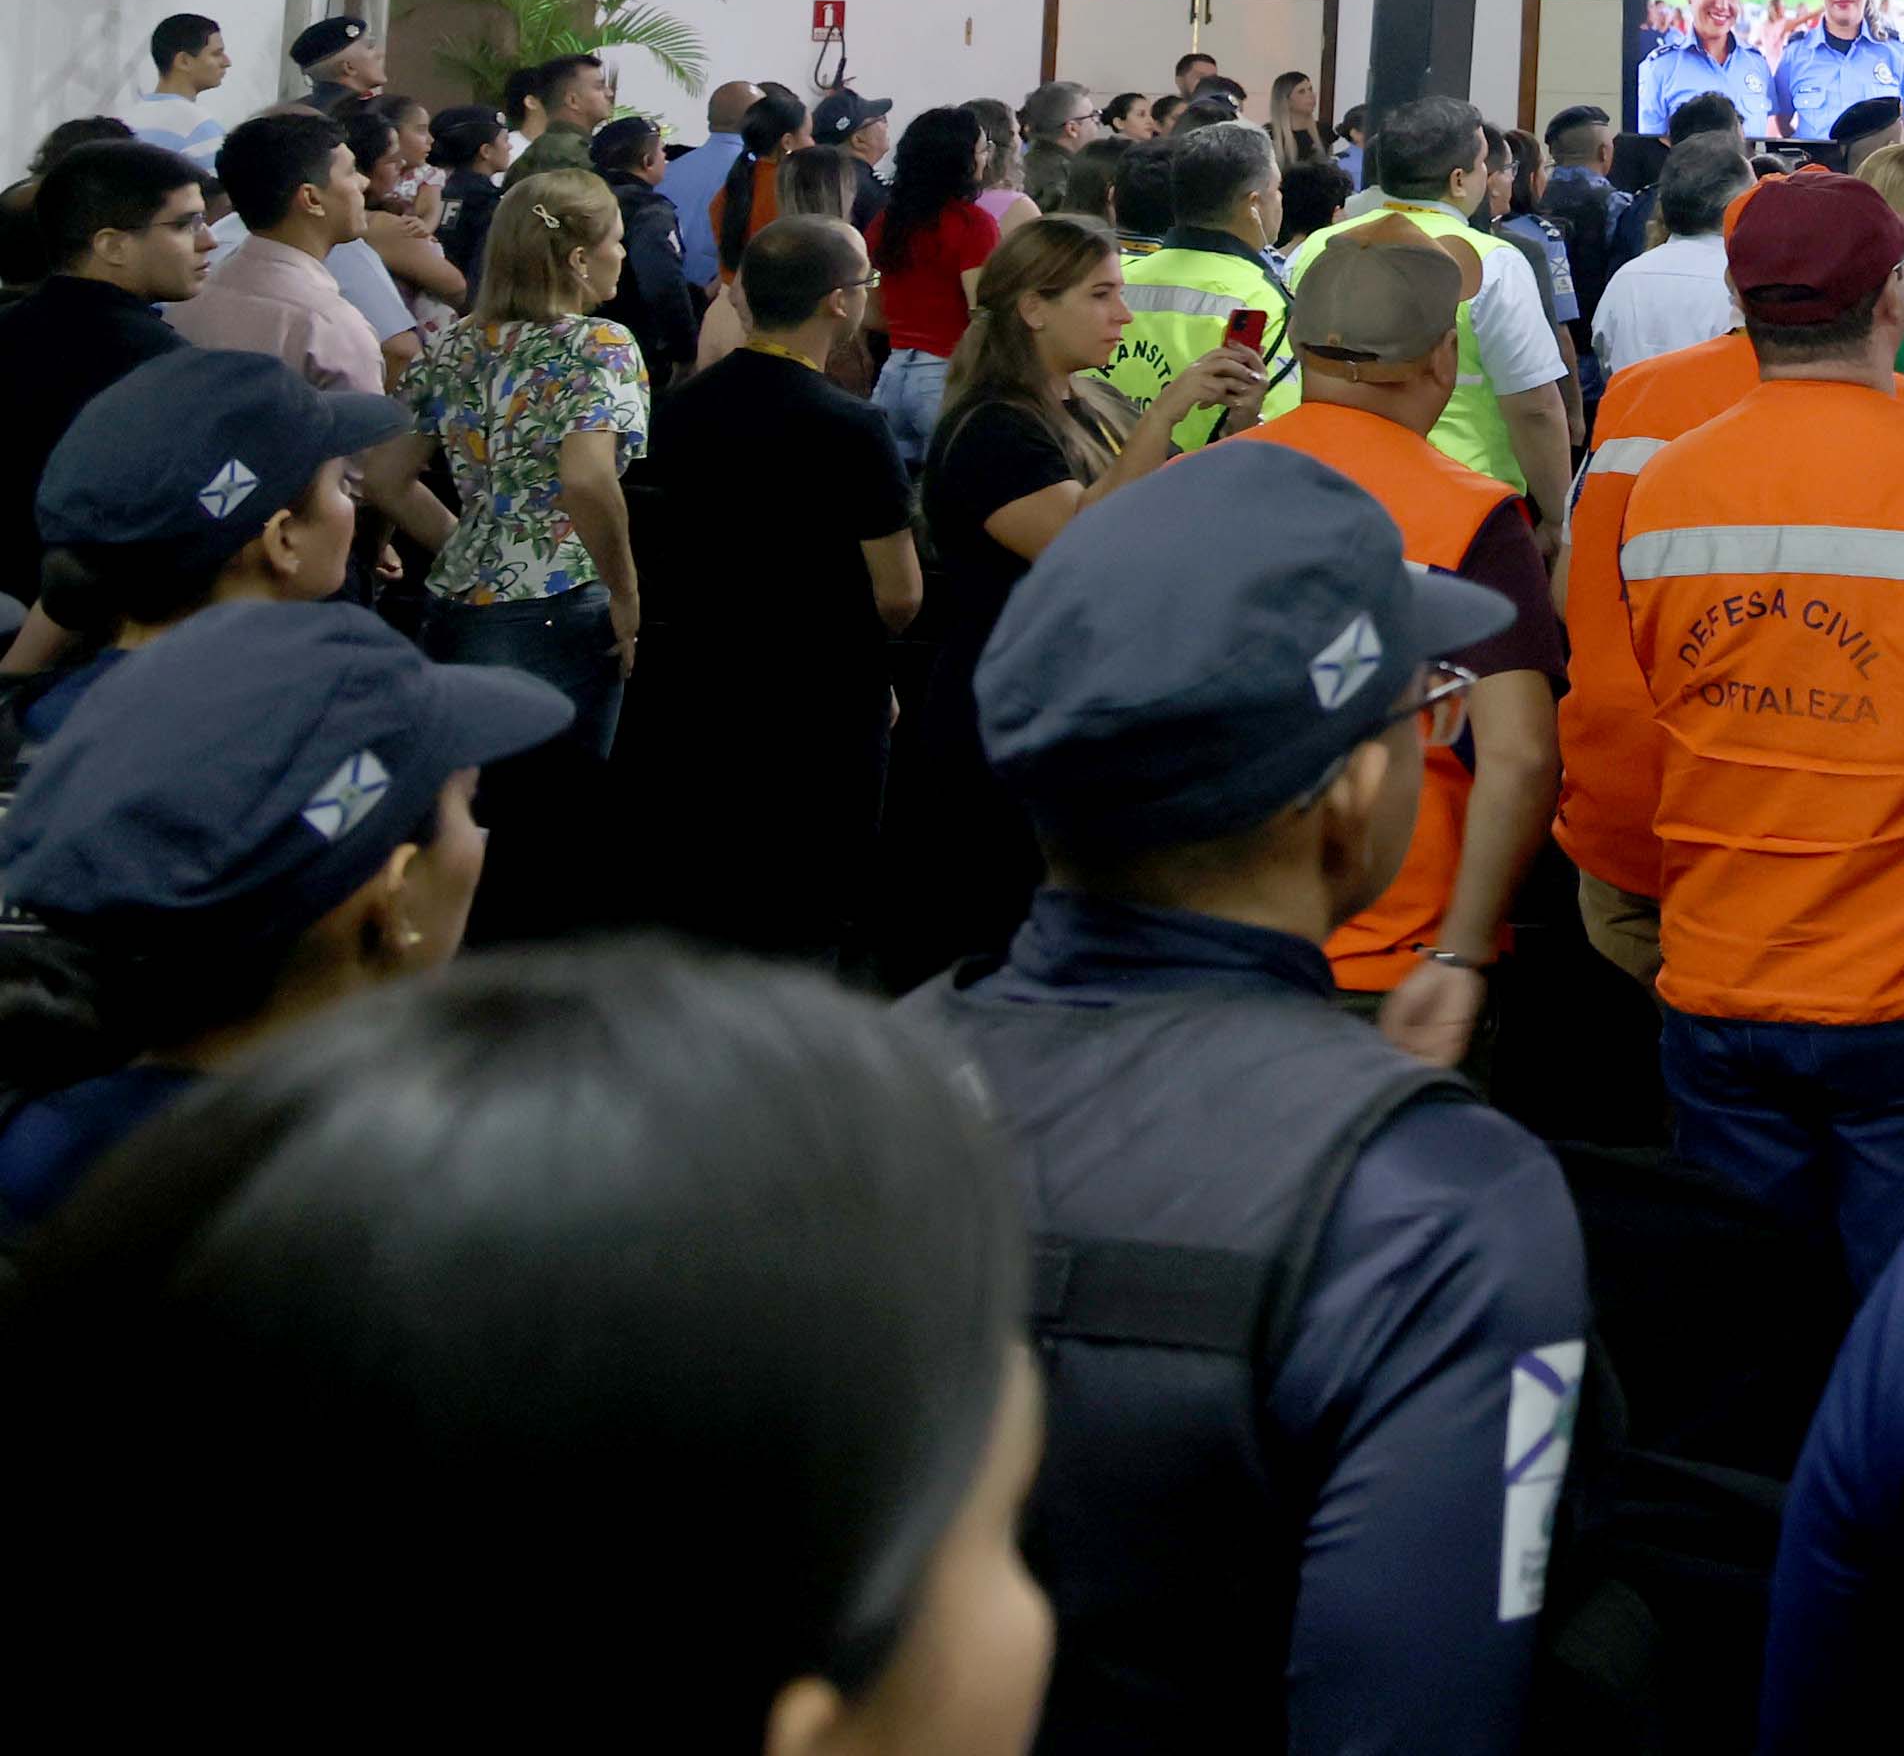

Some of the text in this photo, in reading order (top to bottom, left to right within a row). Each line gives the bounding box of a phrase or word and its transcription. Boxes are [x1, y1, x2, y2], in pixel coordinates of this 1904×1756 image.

[1679, 588, 1881, 681] DEFESA CIVIL
[1680, 682, 1881, 725] FORTALEZA
